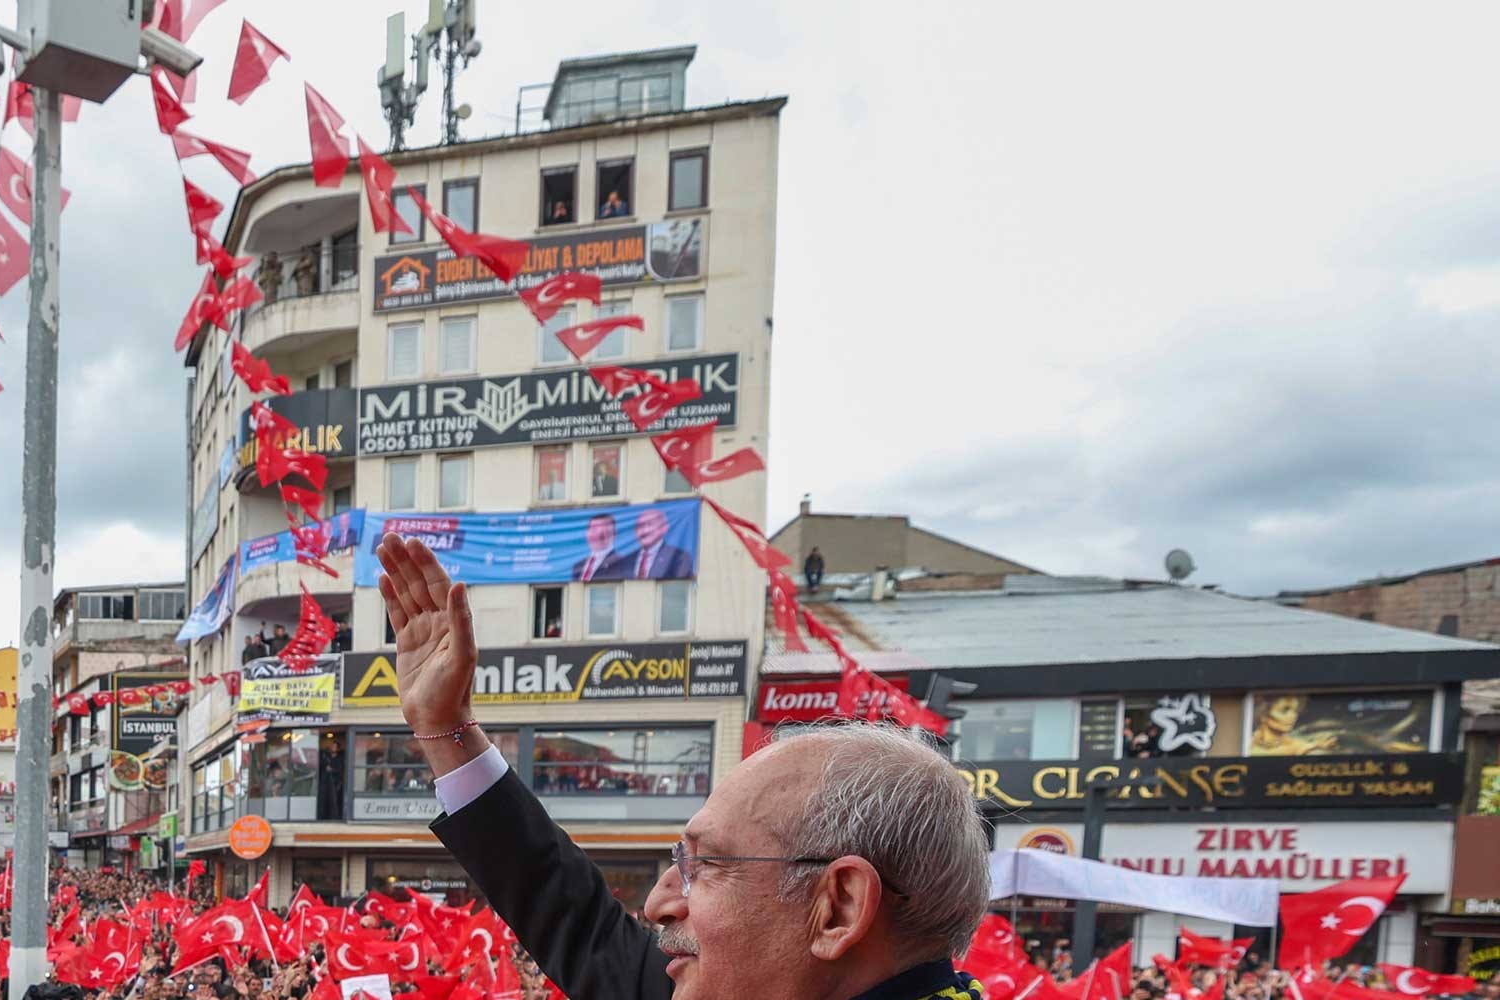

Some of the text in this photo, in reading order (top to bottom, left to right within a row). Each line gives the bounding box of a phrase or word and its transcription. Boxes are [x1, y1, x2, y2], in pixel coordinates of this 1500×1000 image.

[576, 236, 644, 267] DEPOLAMA
[360, 384, 478, 424] MİR
[361, 420, 416, 439] AHMET
[364, 437, 406, 453] 0506
[455, 429, 474, 445] 99
[474, 655, 574, 694] mlak
[603, 658, 685, 681] AYSON
[122, 719, 177, 734] İSTANBUL
[363, 801, 400, 815] Emin
[1196, 826, 1299, 851] ZİRVE
[1196, 852, 1407, 881] MAMÜLLERİ
